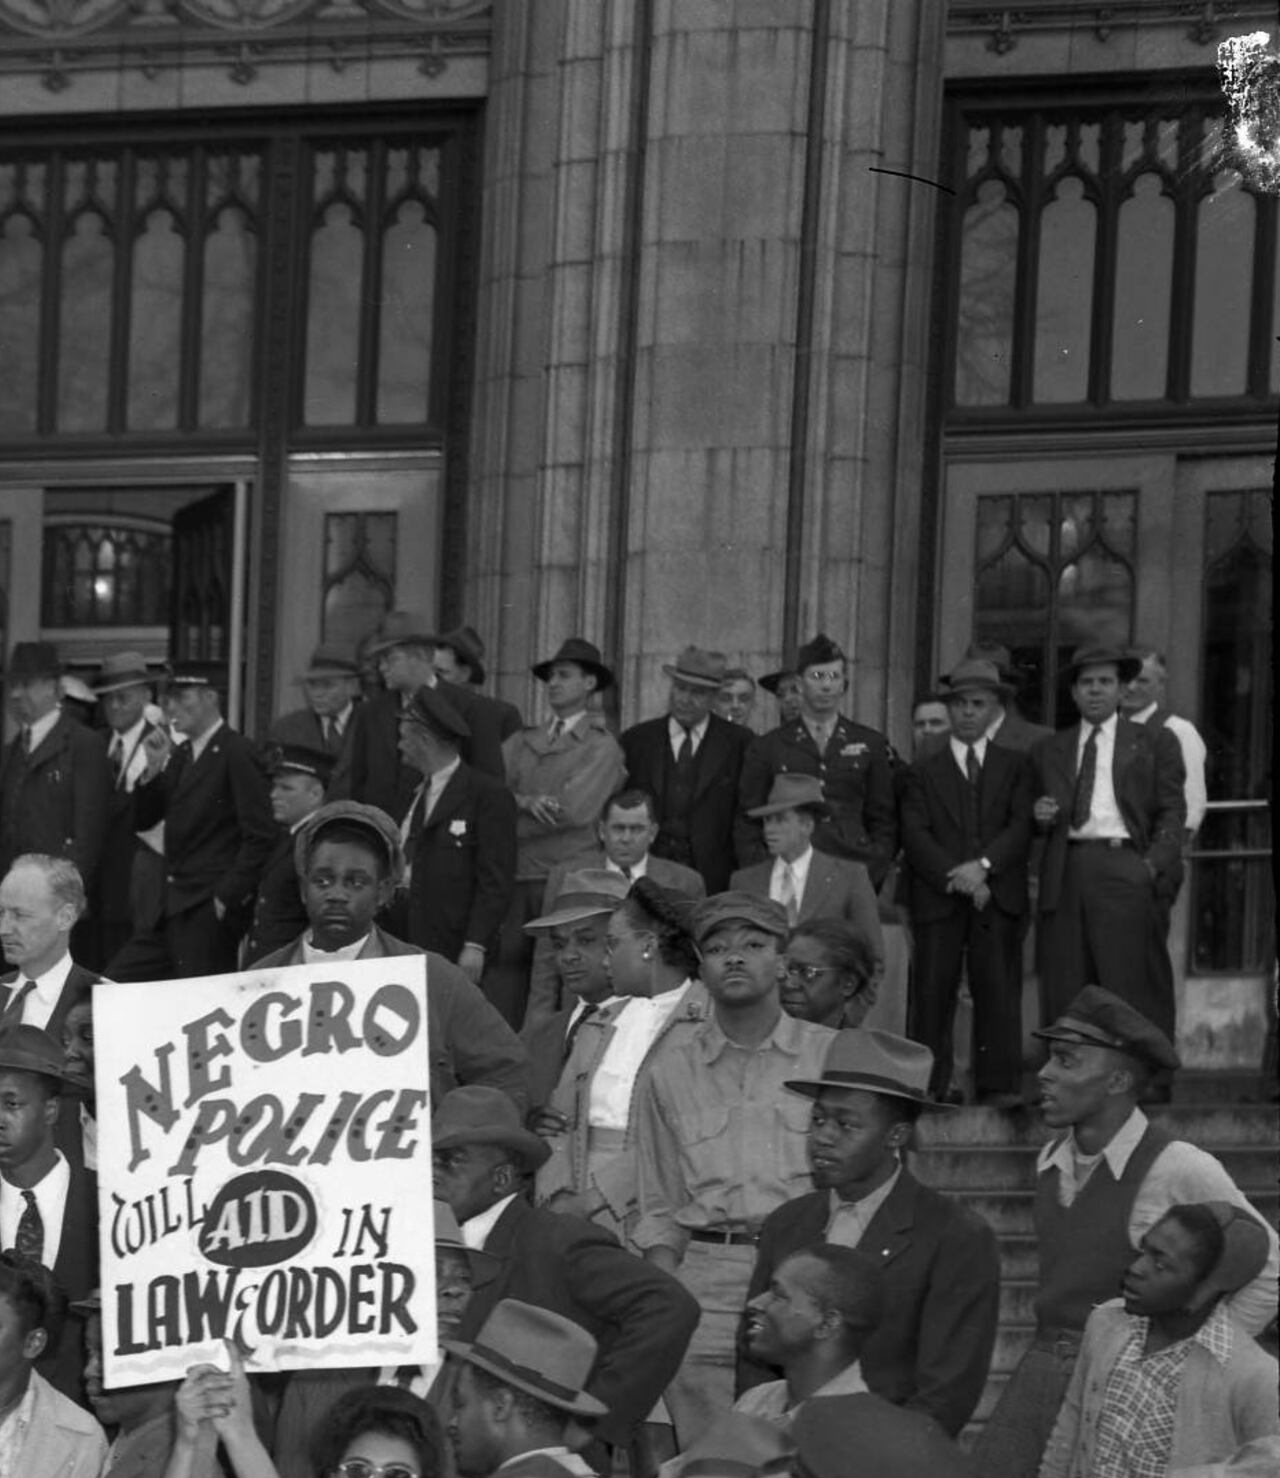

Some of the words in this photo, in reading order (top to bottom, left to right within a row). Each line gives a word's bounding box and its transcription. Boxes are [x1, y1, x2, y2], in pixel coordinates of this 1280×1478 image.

[119, 981, 421, 1173] NEGRO
[168, 1089, 428, 1177] POLICE
[111, 1178, 209, 1258] WILL
[203, 1186, 308, 1253] AID
[333, 1203, 392, 1258] IN
[114, 1267, 242, 1356] LAW
[256, 1262, 418, 1340] ORDER
